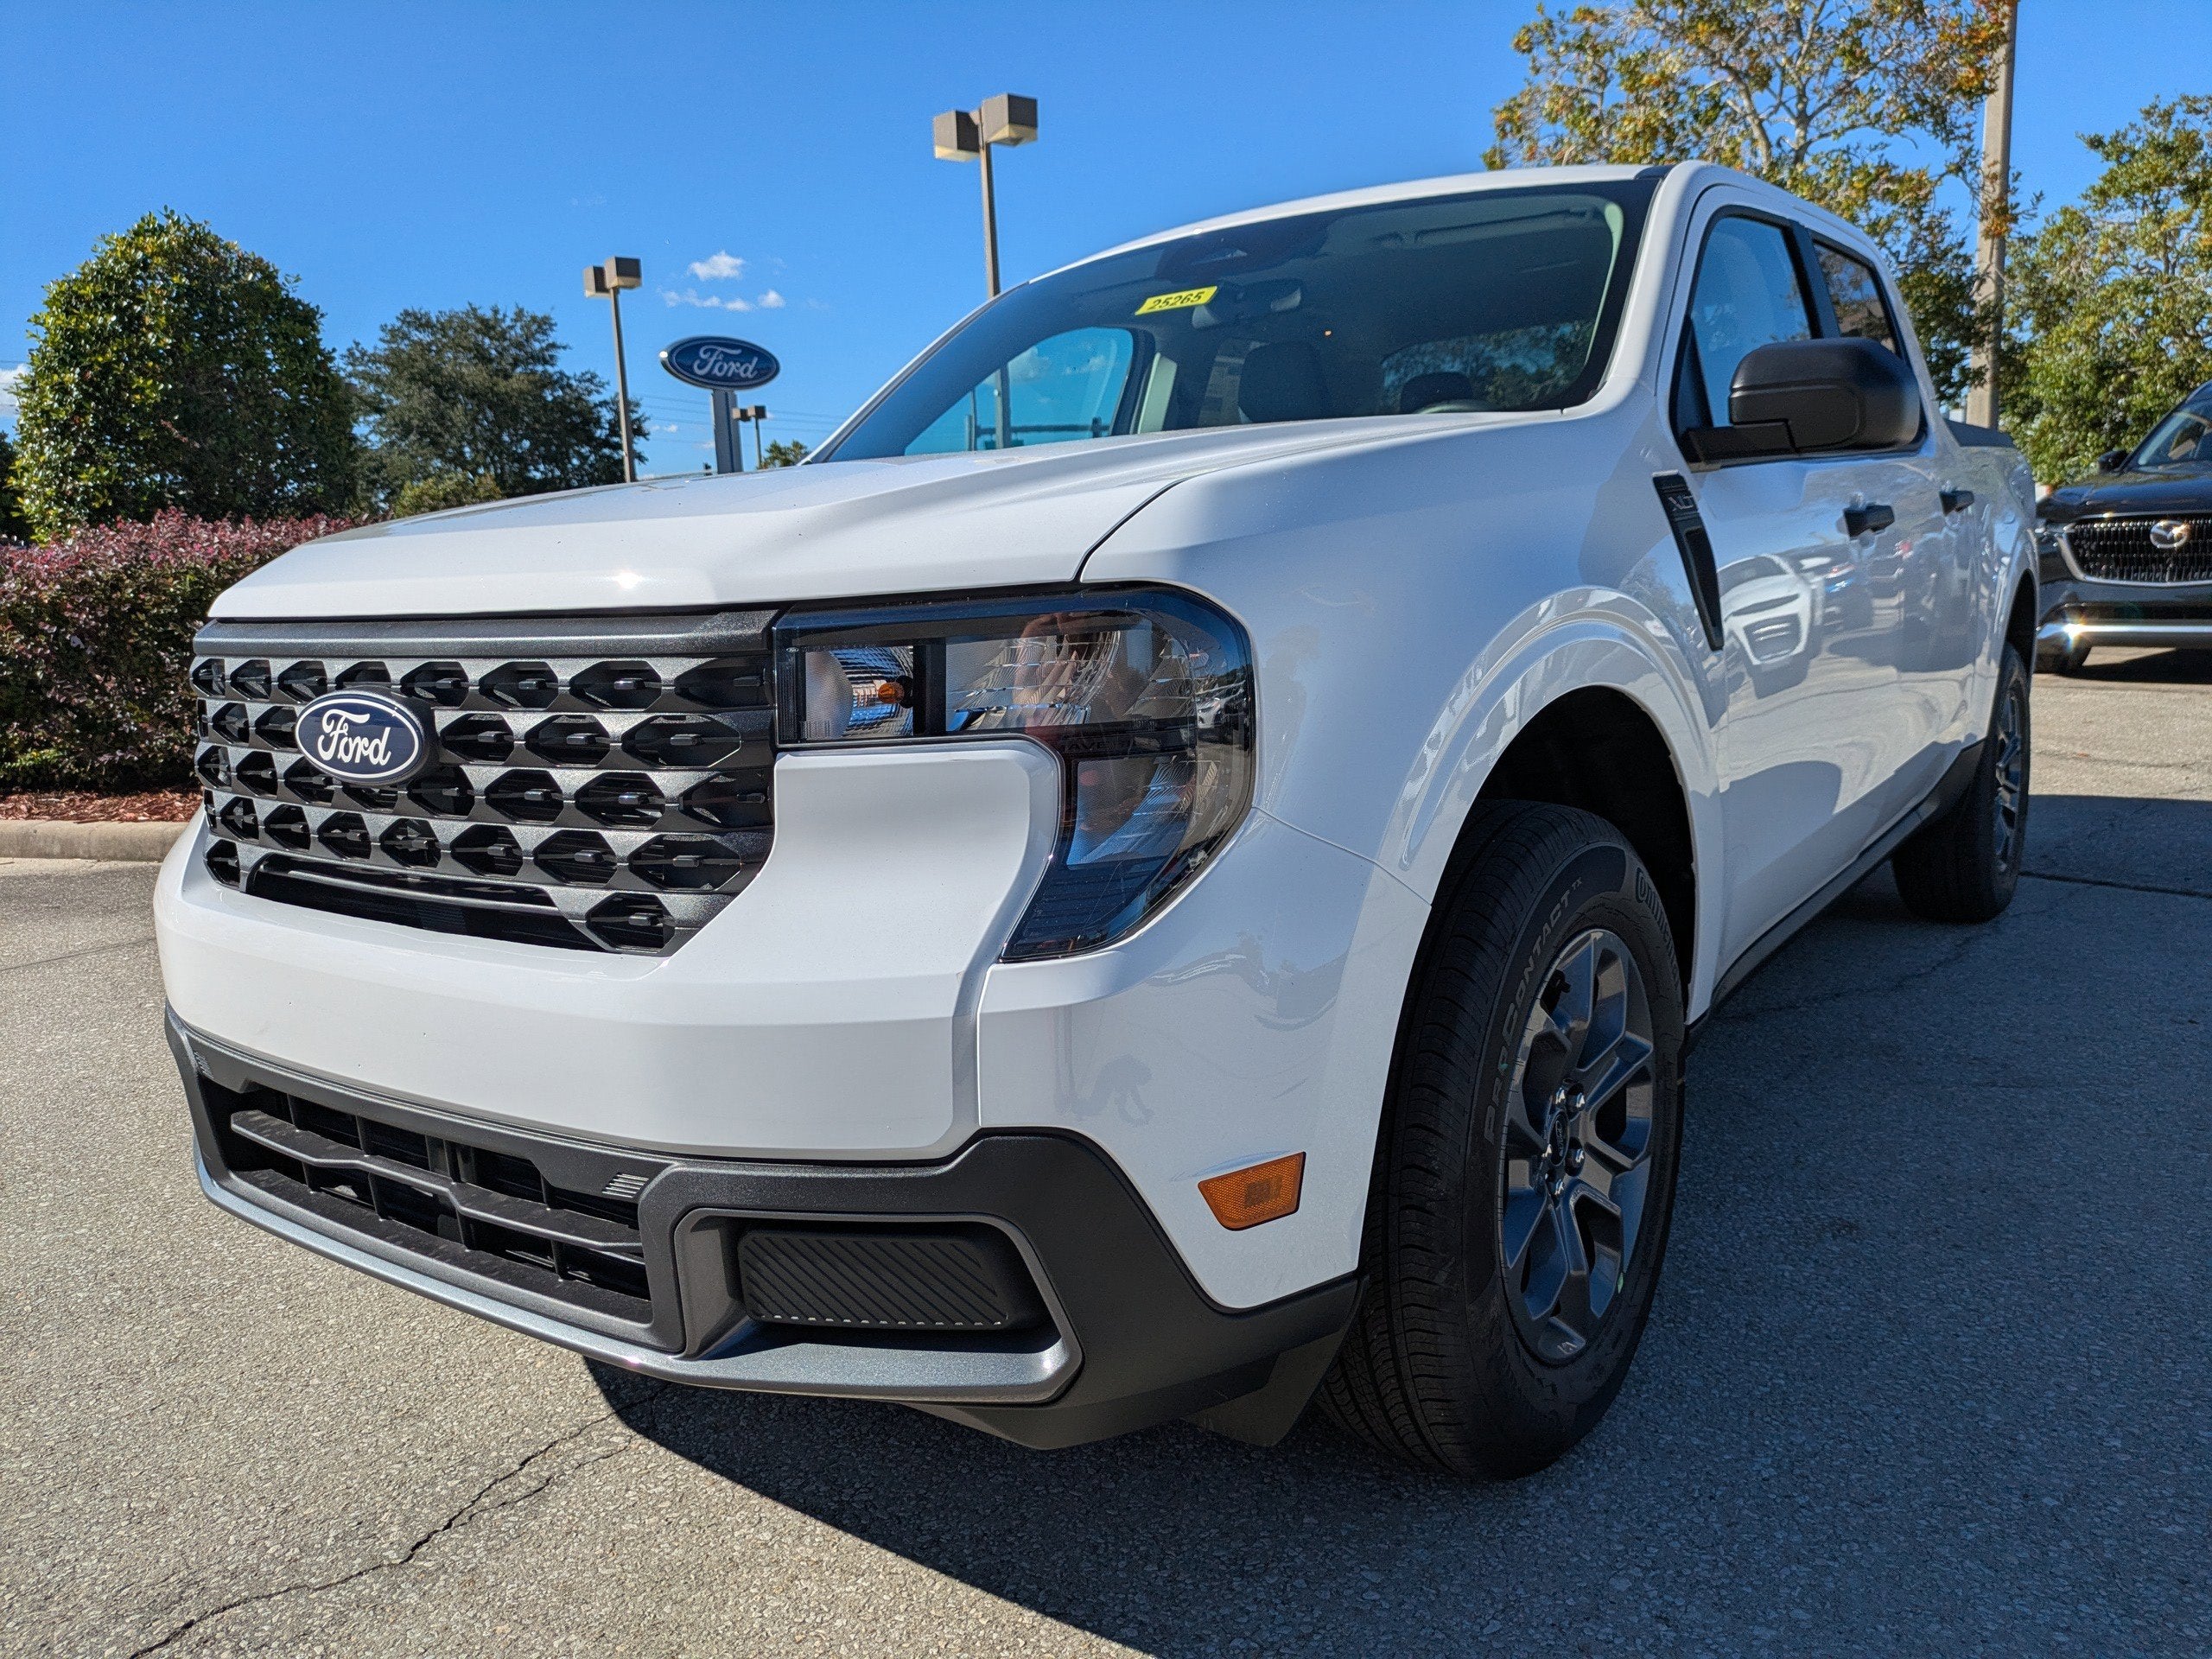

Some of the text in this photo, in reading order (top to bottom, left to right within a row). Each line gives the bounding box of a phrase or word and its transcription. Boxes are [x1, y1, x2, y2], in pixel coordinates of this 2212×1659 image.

[1147, 290, 1206, 311] 25265
[693, 345, 759, 378] Ford
[316, 709, 392, 766] Ford
